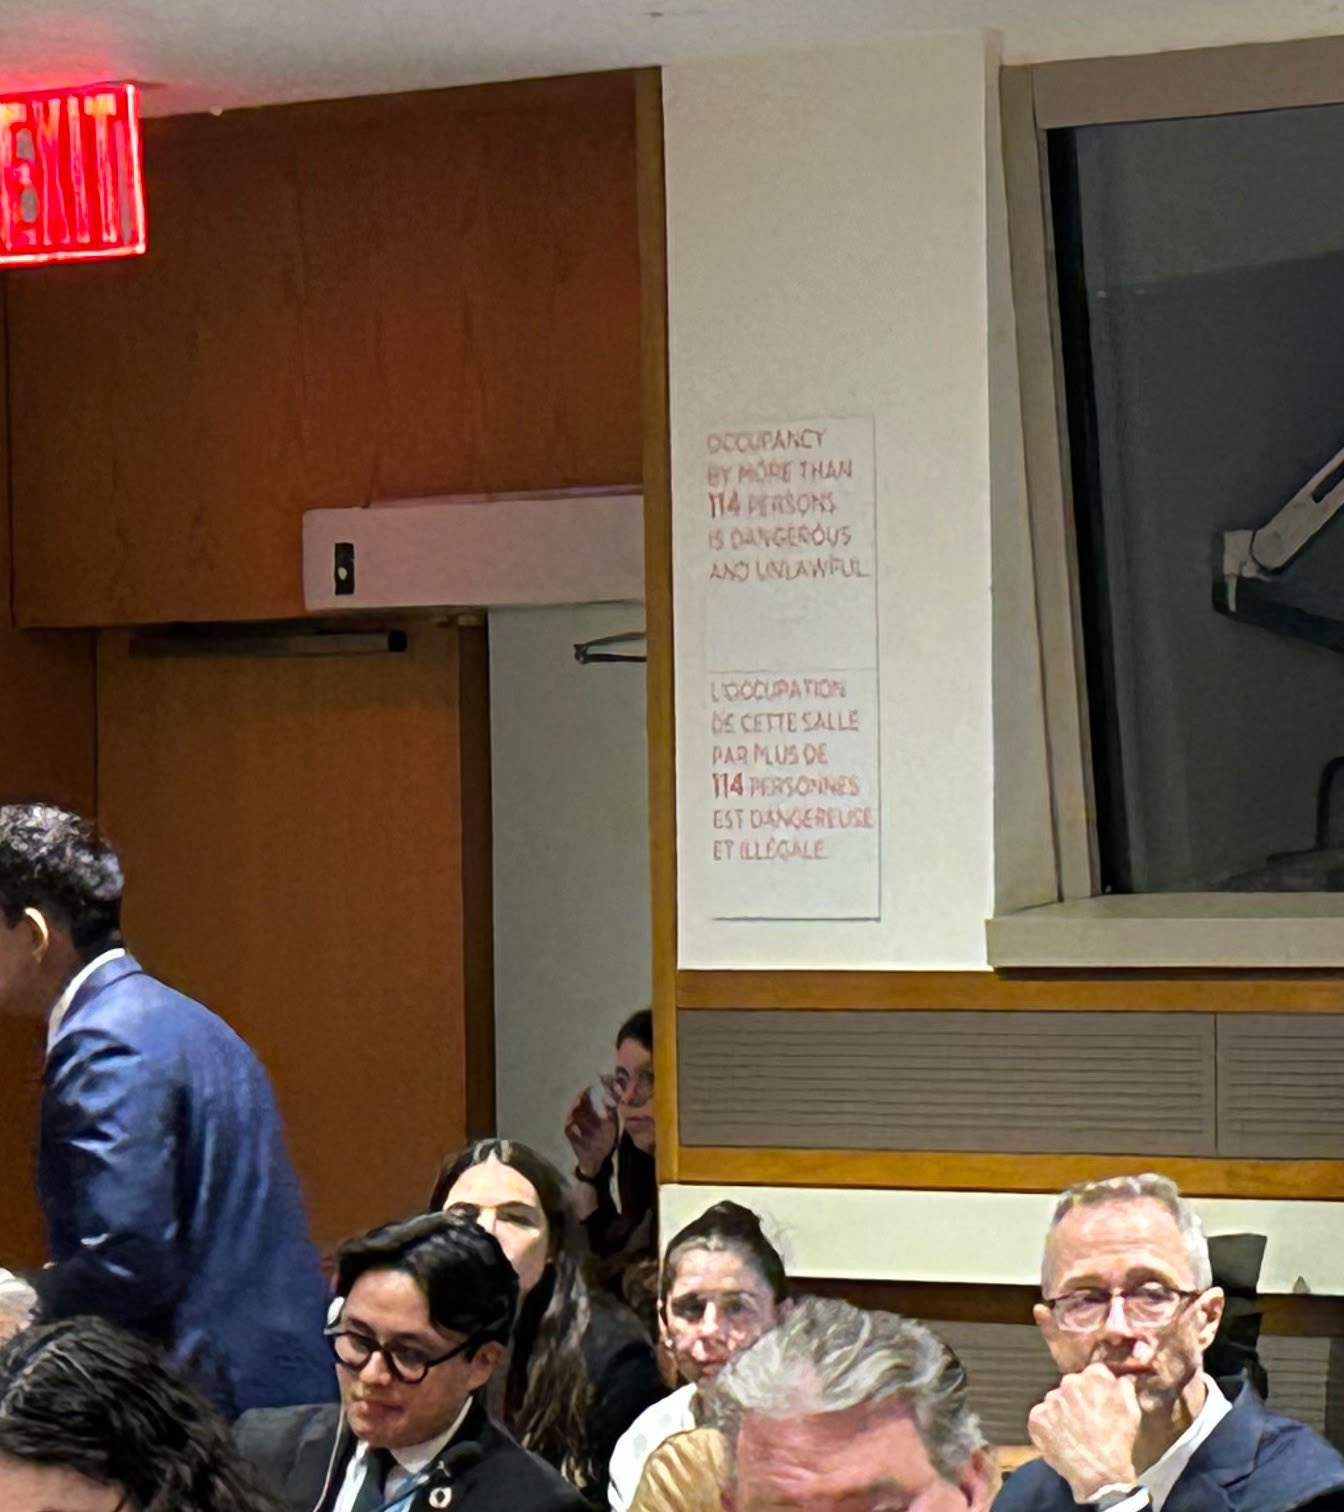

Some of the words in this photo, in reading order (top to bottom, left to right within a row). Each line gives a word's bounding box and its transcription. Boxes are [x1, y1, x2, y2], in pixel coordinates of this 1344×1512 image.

[707, 429, 825, 453] OCCUPANCY
[738, 458, 793, 484] MORE
[799, 459, 853, 479] THAN
[707, 492, 741, 518] 114
[747, 491, 838, 516] PERSONS
[709, 530, 725, 551] IS
[730, 525, 851, 549] DANGEROUS
[709, 561, 749, 581] AND
[755, 557, 869, 580] UNLAWFUL
[711, 711, 735, 735] DE
[740, 712, 798, 734] CETTE
[802, 709, 859, 732] SALLE
[712, 745, 748, 766] PAR
[753, 743, 799, 766] PLUS
[803, 743, 828, 765] DE
[712, 772, 744, 799] 114
[750, 774, 860, 798] PERSONNES
[713, 808, 744, 830] EST
[750, 806, 873, 830] DANGEREUSE
[713, 839, 734, 861] ET
